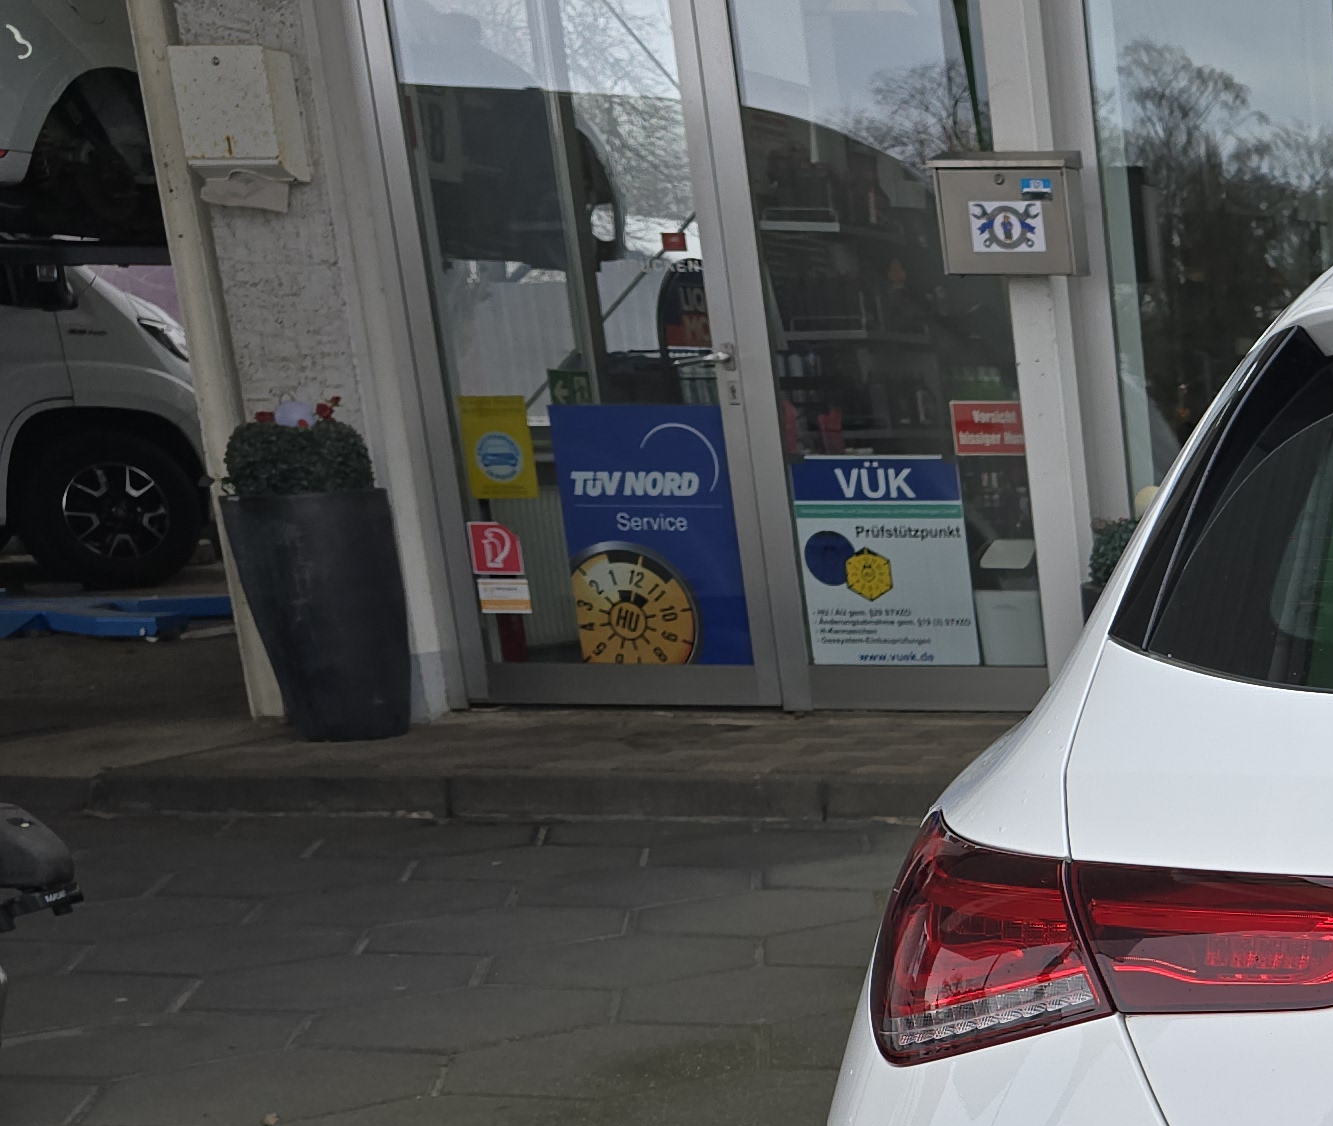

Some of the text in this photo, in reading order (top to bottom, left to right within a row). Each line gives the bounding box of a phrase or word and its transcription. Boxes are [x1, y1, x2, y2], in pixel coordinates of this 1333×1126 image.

[570, 471, 699, 497] TÜV NORD
[834, 461, 916, 498] VÜK
[615, 512, 688, 531] Service
[855, 525, 961, 541] Prüfstützpunkt
[628, 569, 645, 589] 12
[615, 606, 641, 632] HU
